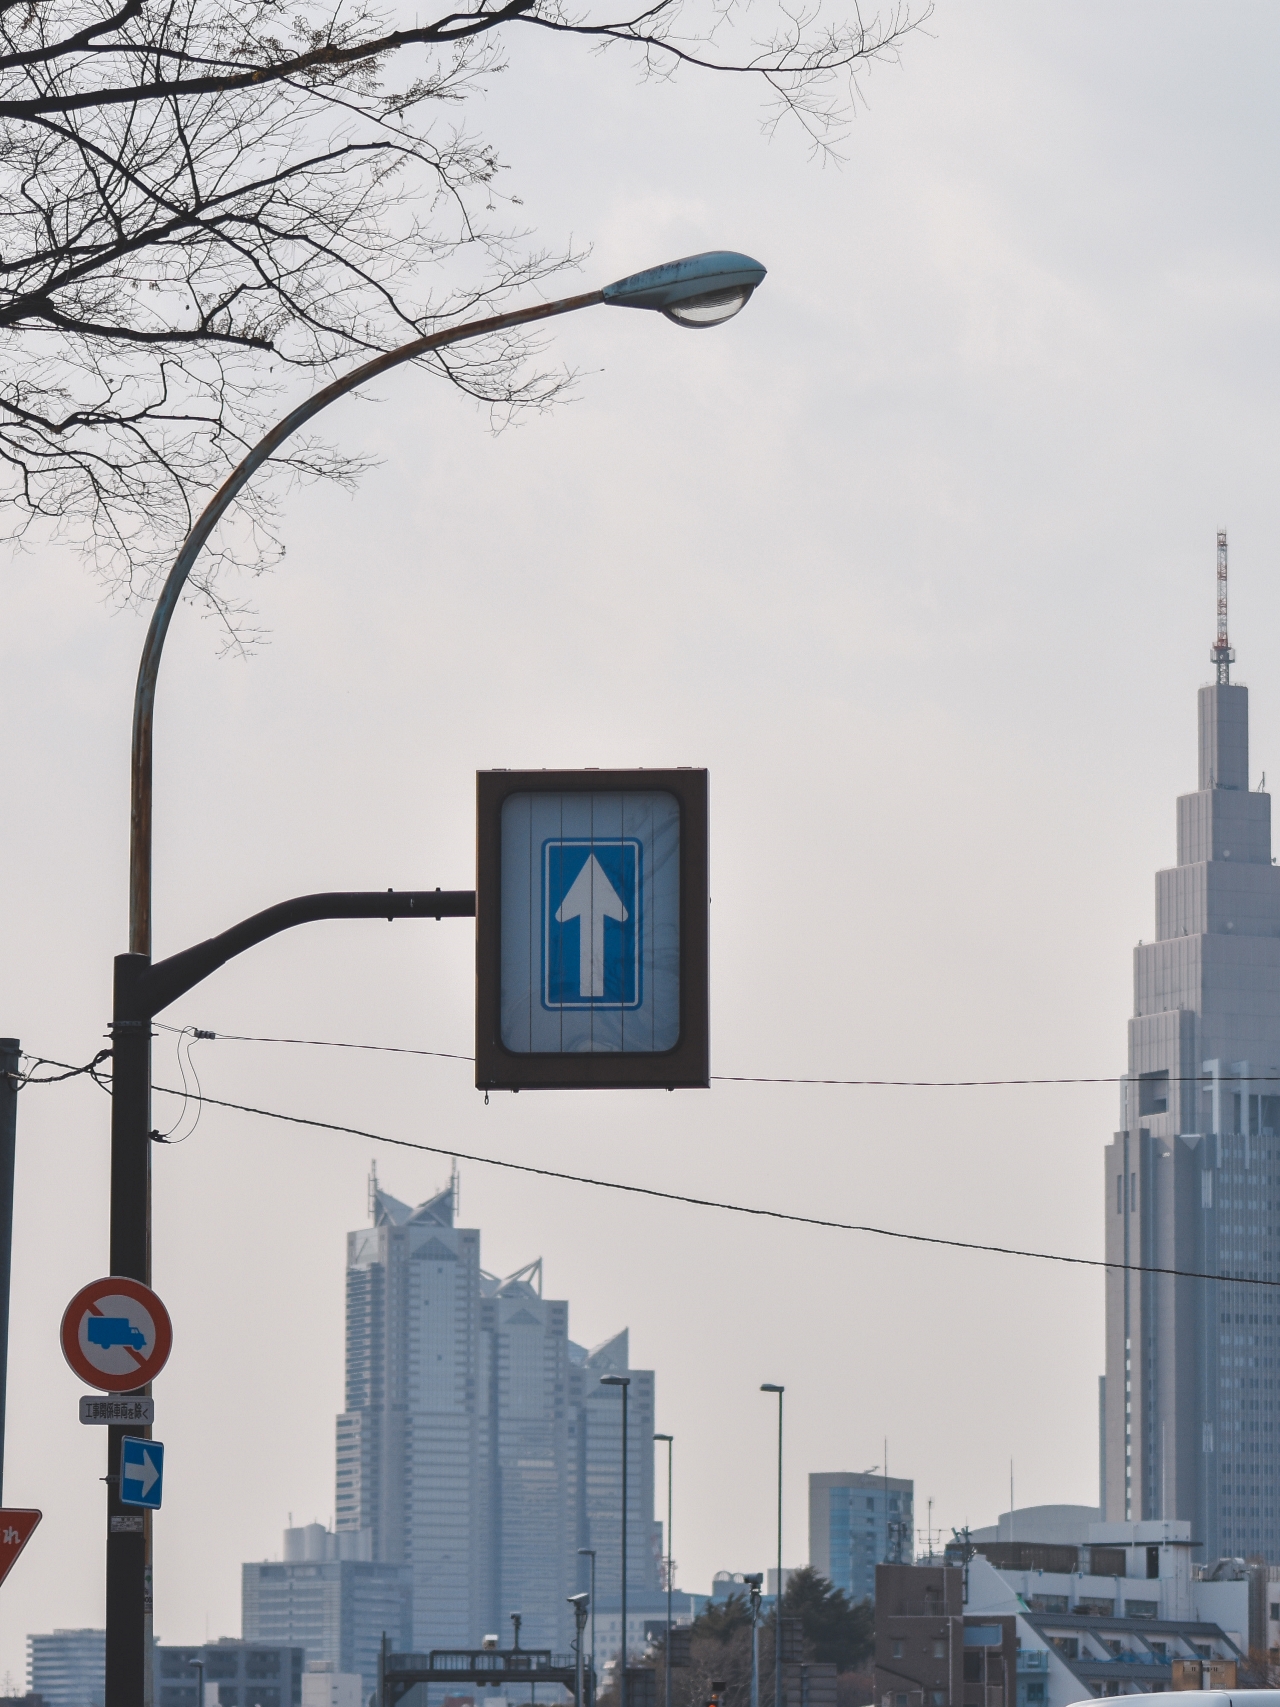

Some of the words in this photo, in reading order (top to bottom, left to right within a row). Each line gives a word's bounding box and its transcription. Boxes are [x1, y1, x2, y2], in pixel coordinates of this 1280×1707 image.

[85, 1402, 149, 1420] 工事関係車両を除く
